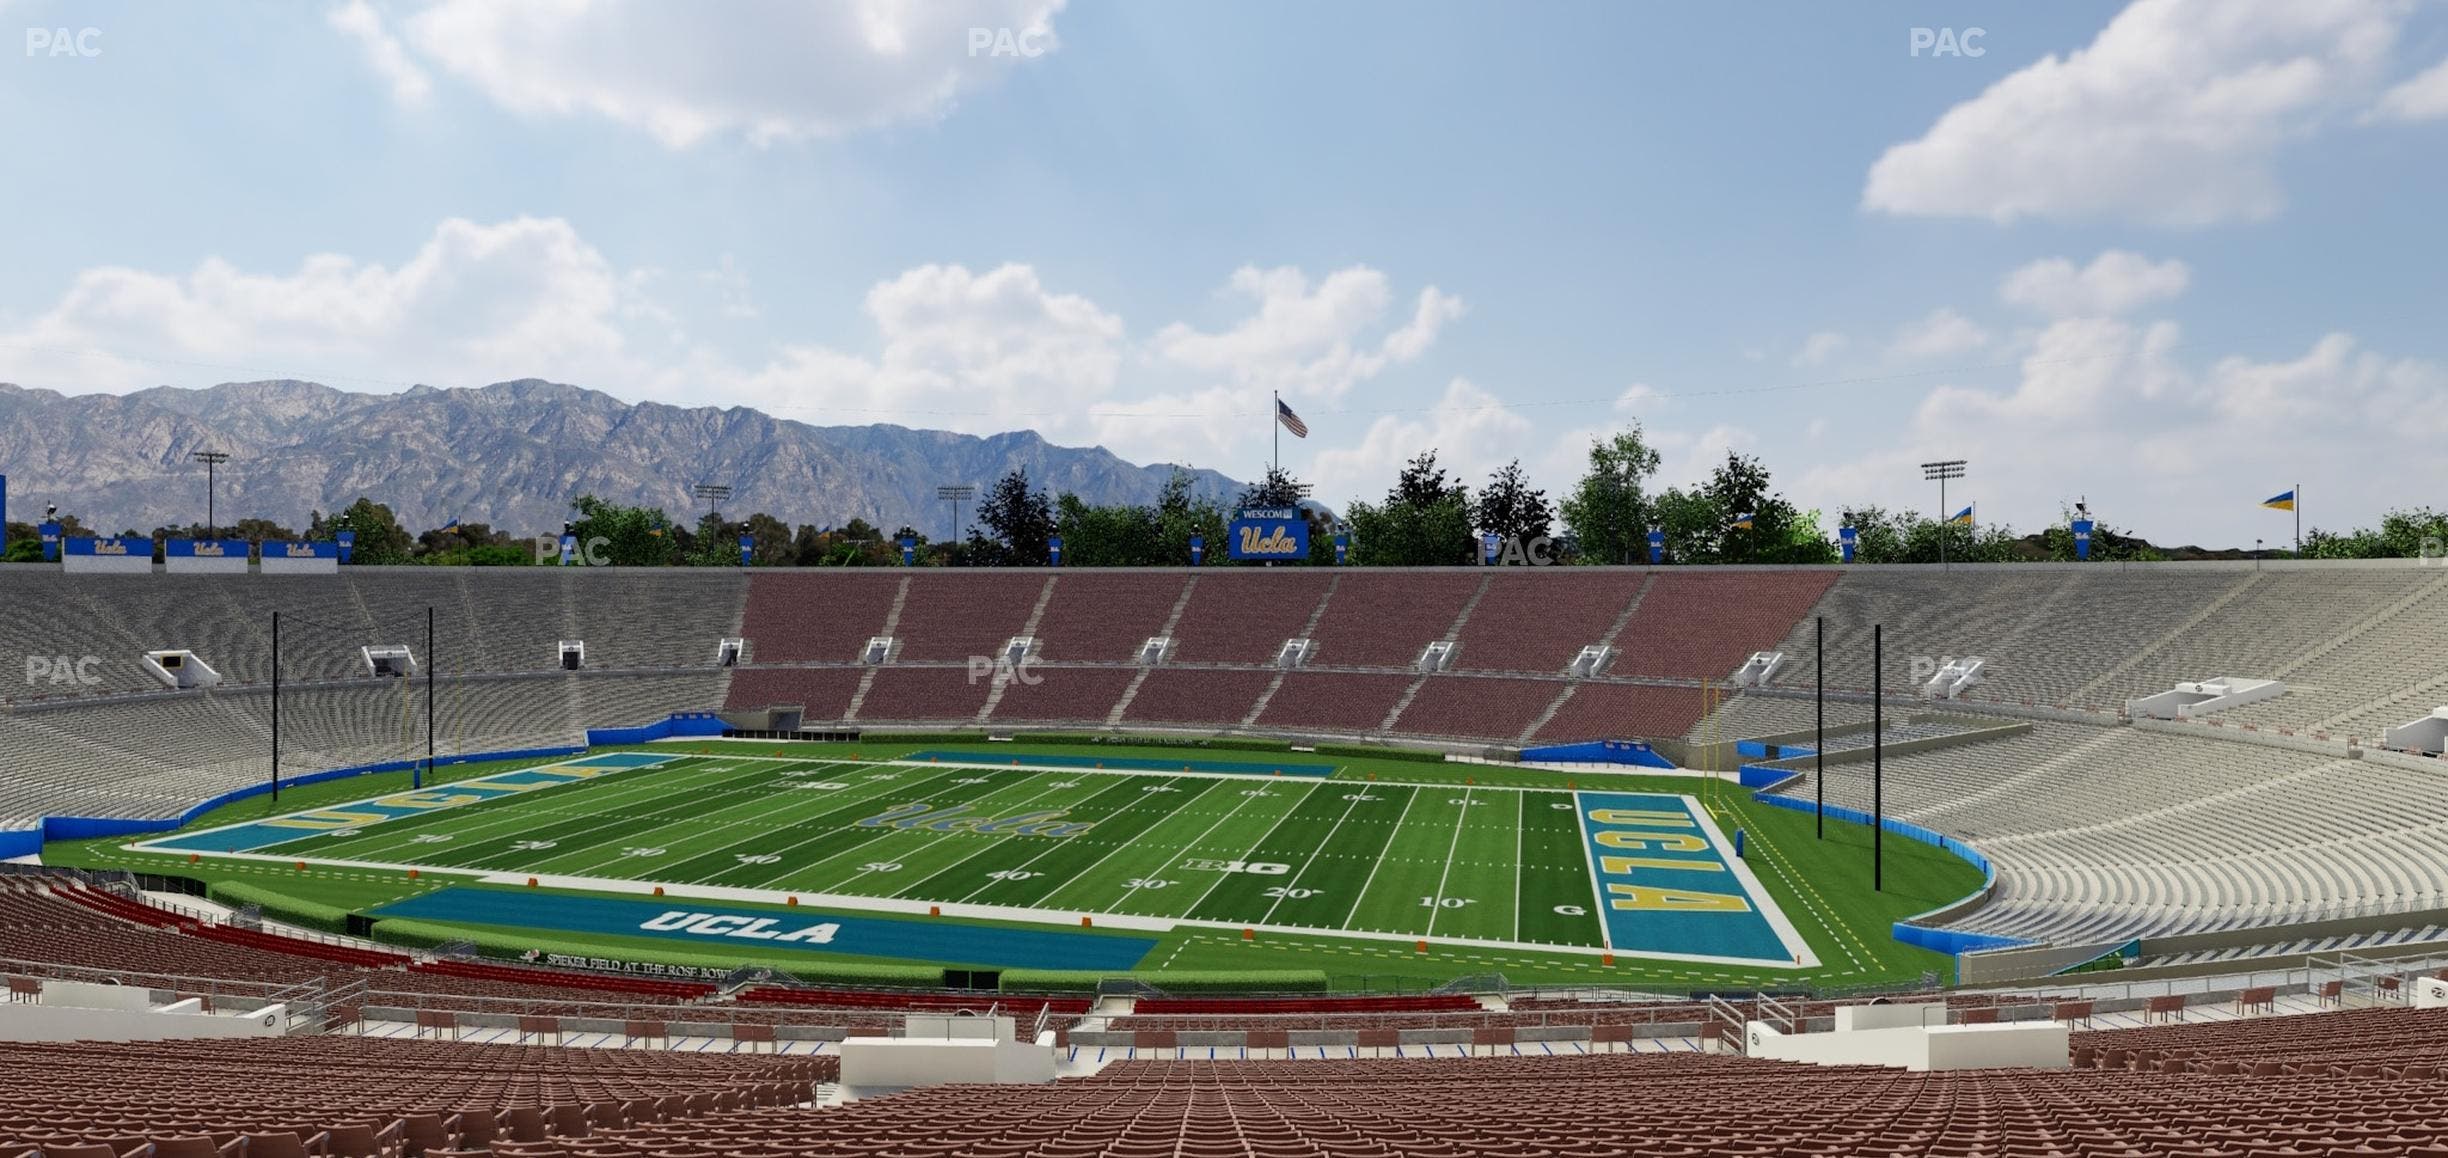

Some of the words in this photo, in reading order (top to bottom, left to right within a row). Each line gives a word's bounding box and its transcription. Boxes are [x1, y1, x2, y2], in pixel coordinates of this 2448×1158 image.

[1243, 510, 1282, 519] WESCOM
[1239, 525, 1298, 554] Ucla
[854, 804, 1096, 837] Ucla
[1588, 808, 1753, 912] UCLA
[856, 862, 903, 873] 50
[985, 870, 1032, 881] 40
[1121, 878, 1167, 889] 30
[1262, 887, 1312, 899] 20
[1418, 896, 1464, 908] 10
[1553, 905, 1588, 916] G
[639, 911, 840, 944] UCLA
[546, 953, 587, 967] SPIEKER
[589, 958, 621, 970] FIELD
[624, 962, 640, 972] AT
[642, 963, 665, 974] THE
[668, 965, 697, 977] ROSE
